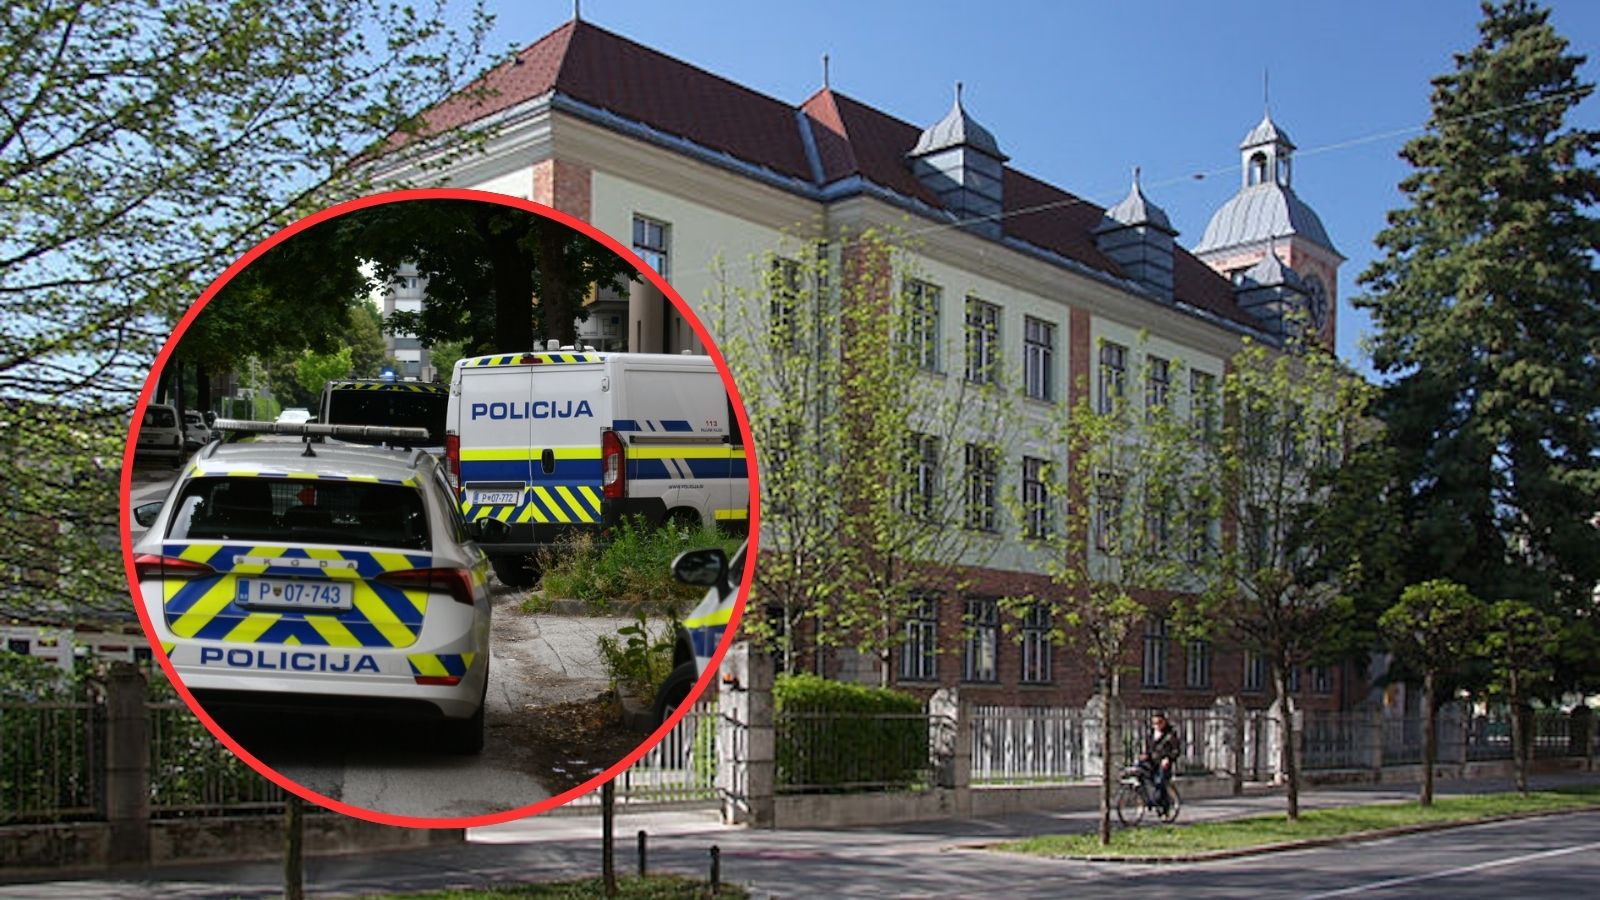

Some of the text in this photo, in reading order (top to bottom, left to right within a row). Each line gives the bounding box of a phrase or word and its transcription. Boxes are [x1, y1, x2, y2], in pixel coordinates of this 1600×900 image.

[471, 400, 593, 420] POLICIJA
[260, 582, 341, 604] P 07-743
[200, 647, 381, 673] POLICIJA
